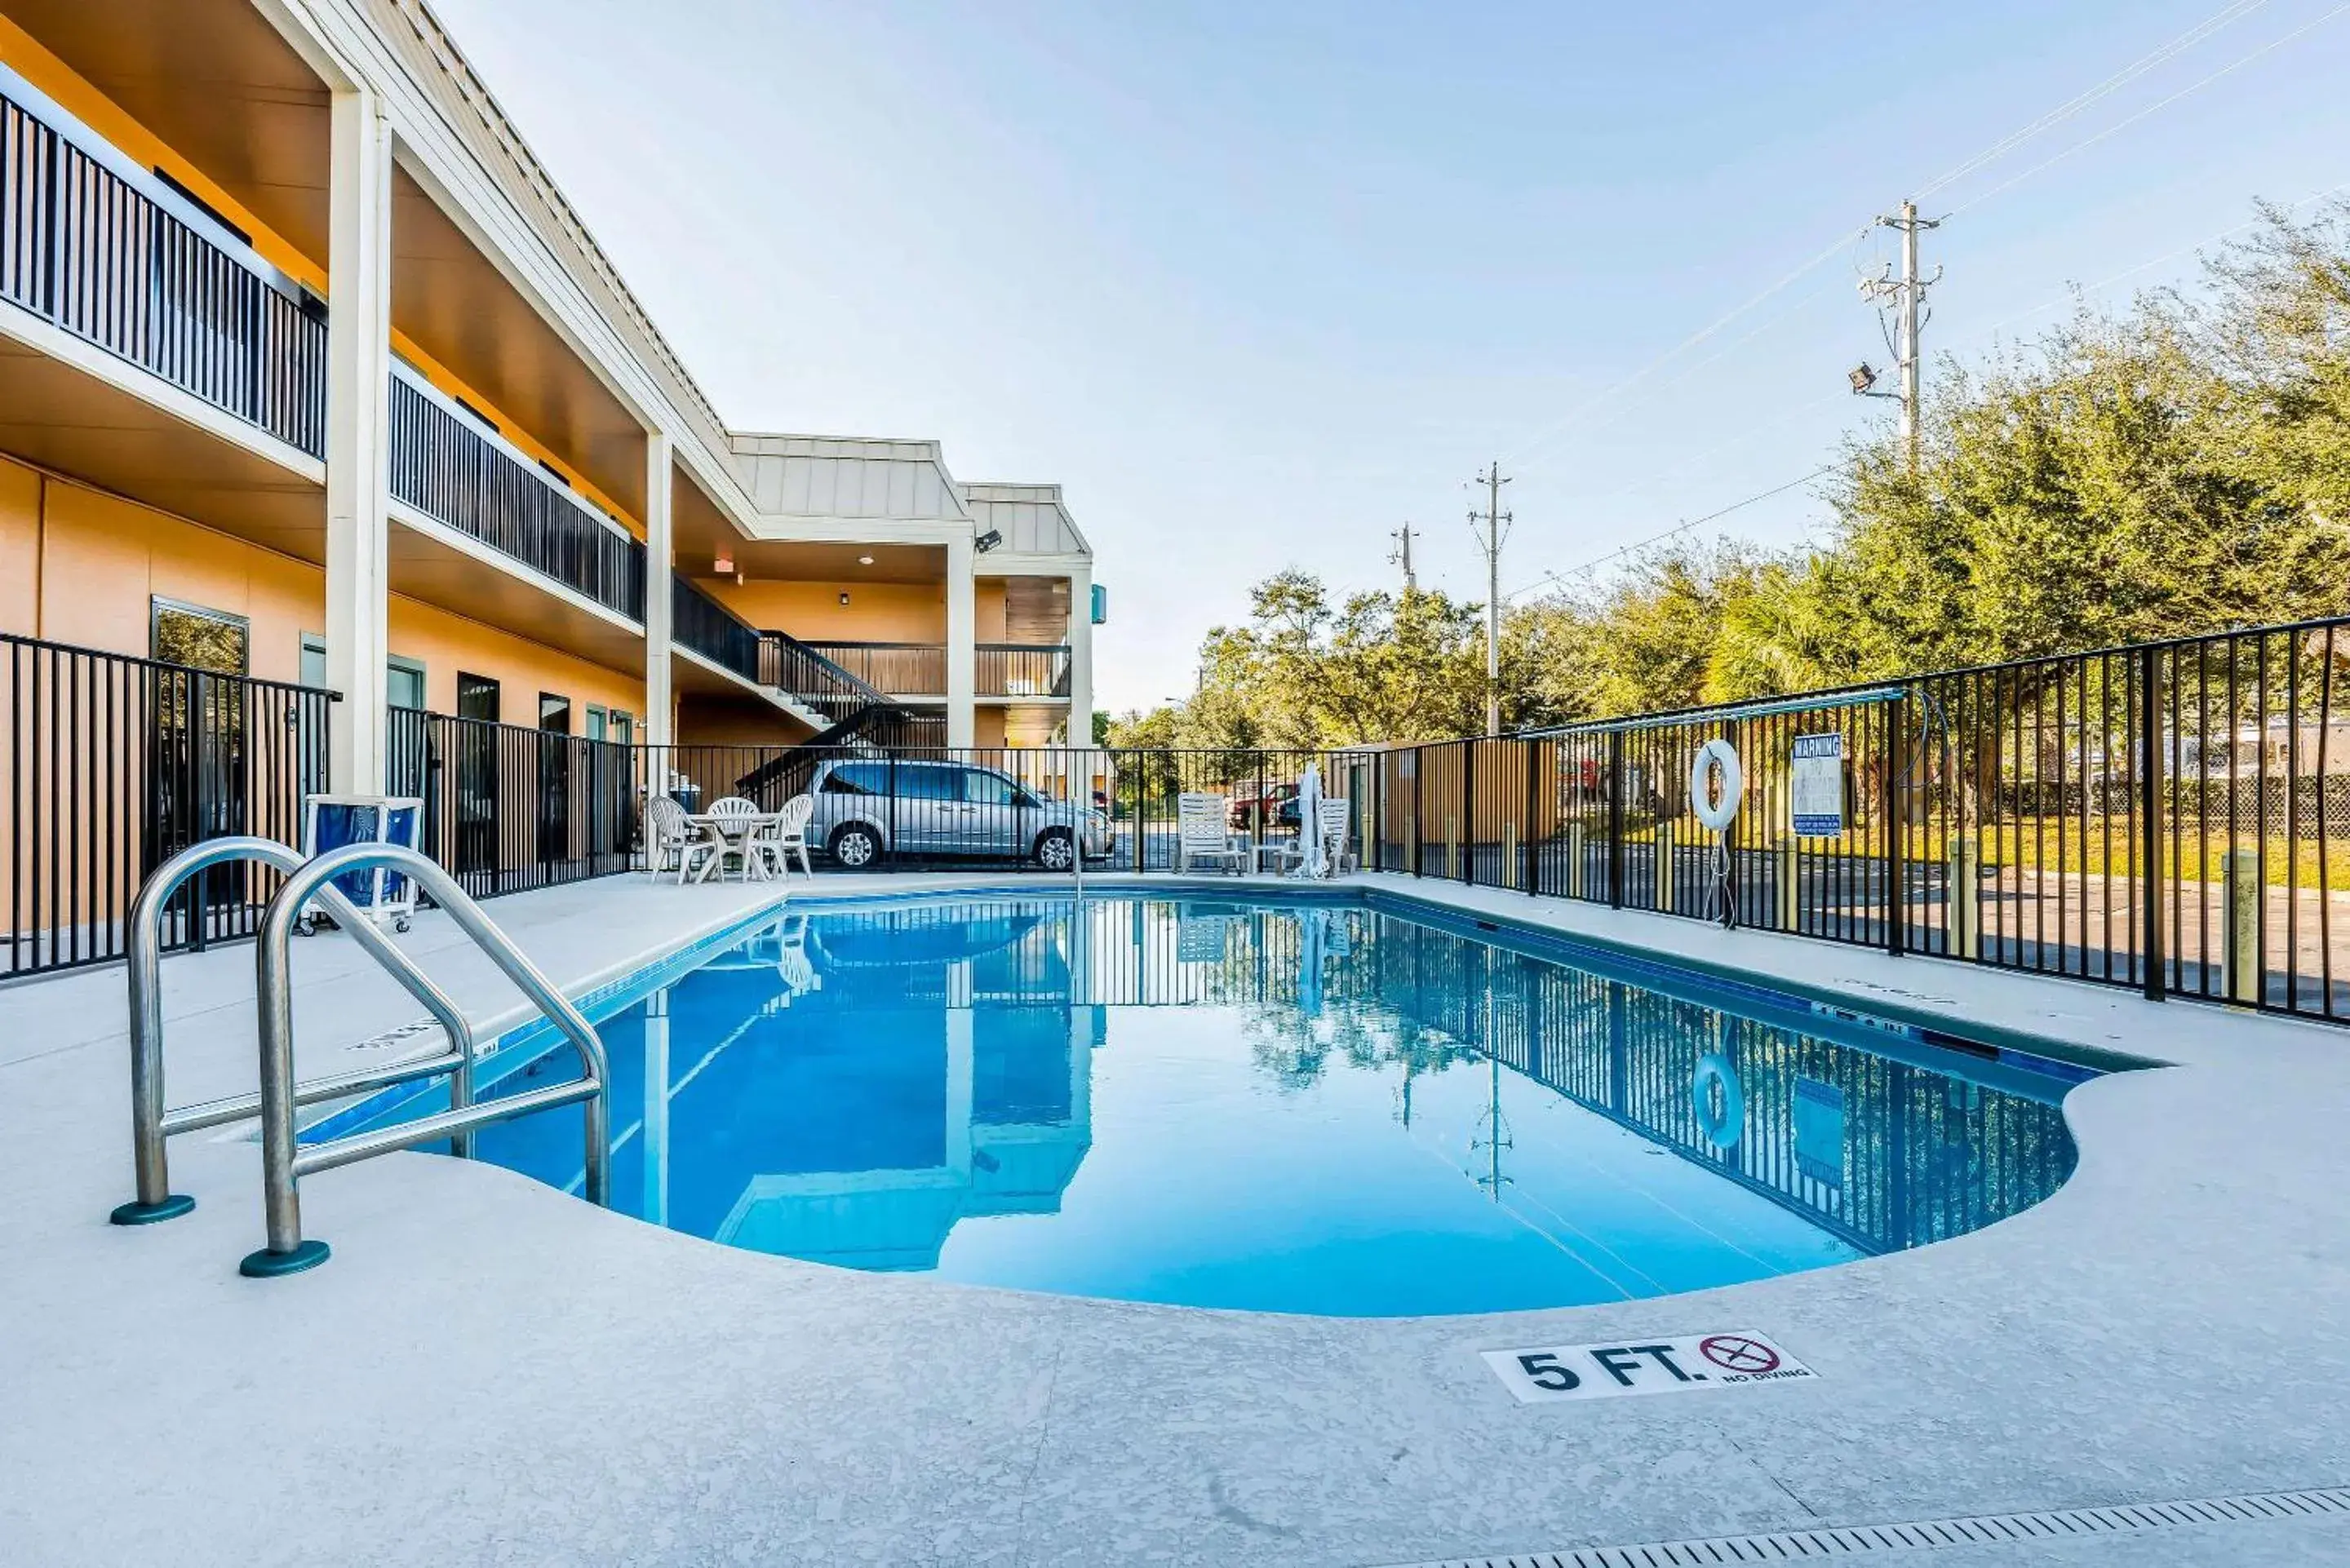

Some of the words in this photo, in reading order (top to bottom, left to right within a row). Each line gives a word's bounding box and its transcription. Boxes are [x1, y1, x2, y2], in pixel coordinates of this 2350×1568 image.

[1795, 735, 1839, 757] WARNING
[1517, 1353, 1581, 1391] 5
[1590, 1344, 1709, 1387] FT.
[1722, 1374, 1749, 1384] NO
[1751, 1368, 1811, 1380] DIVING
